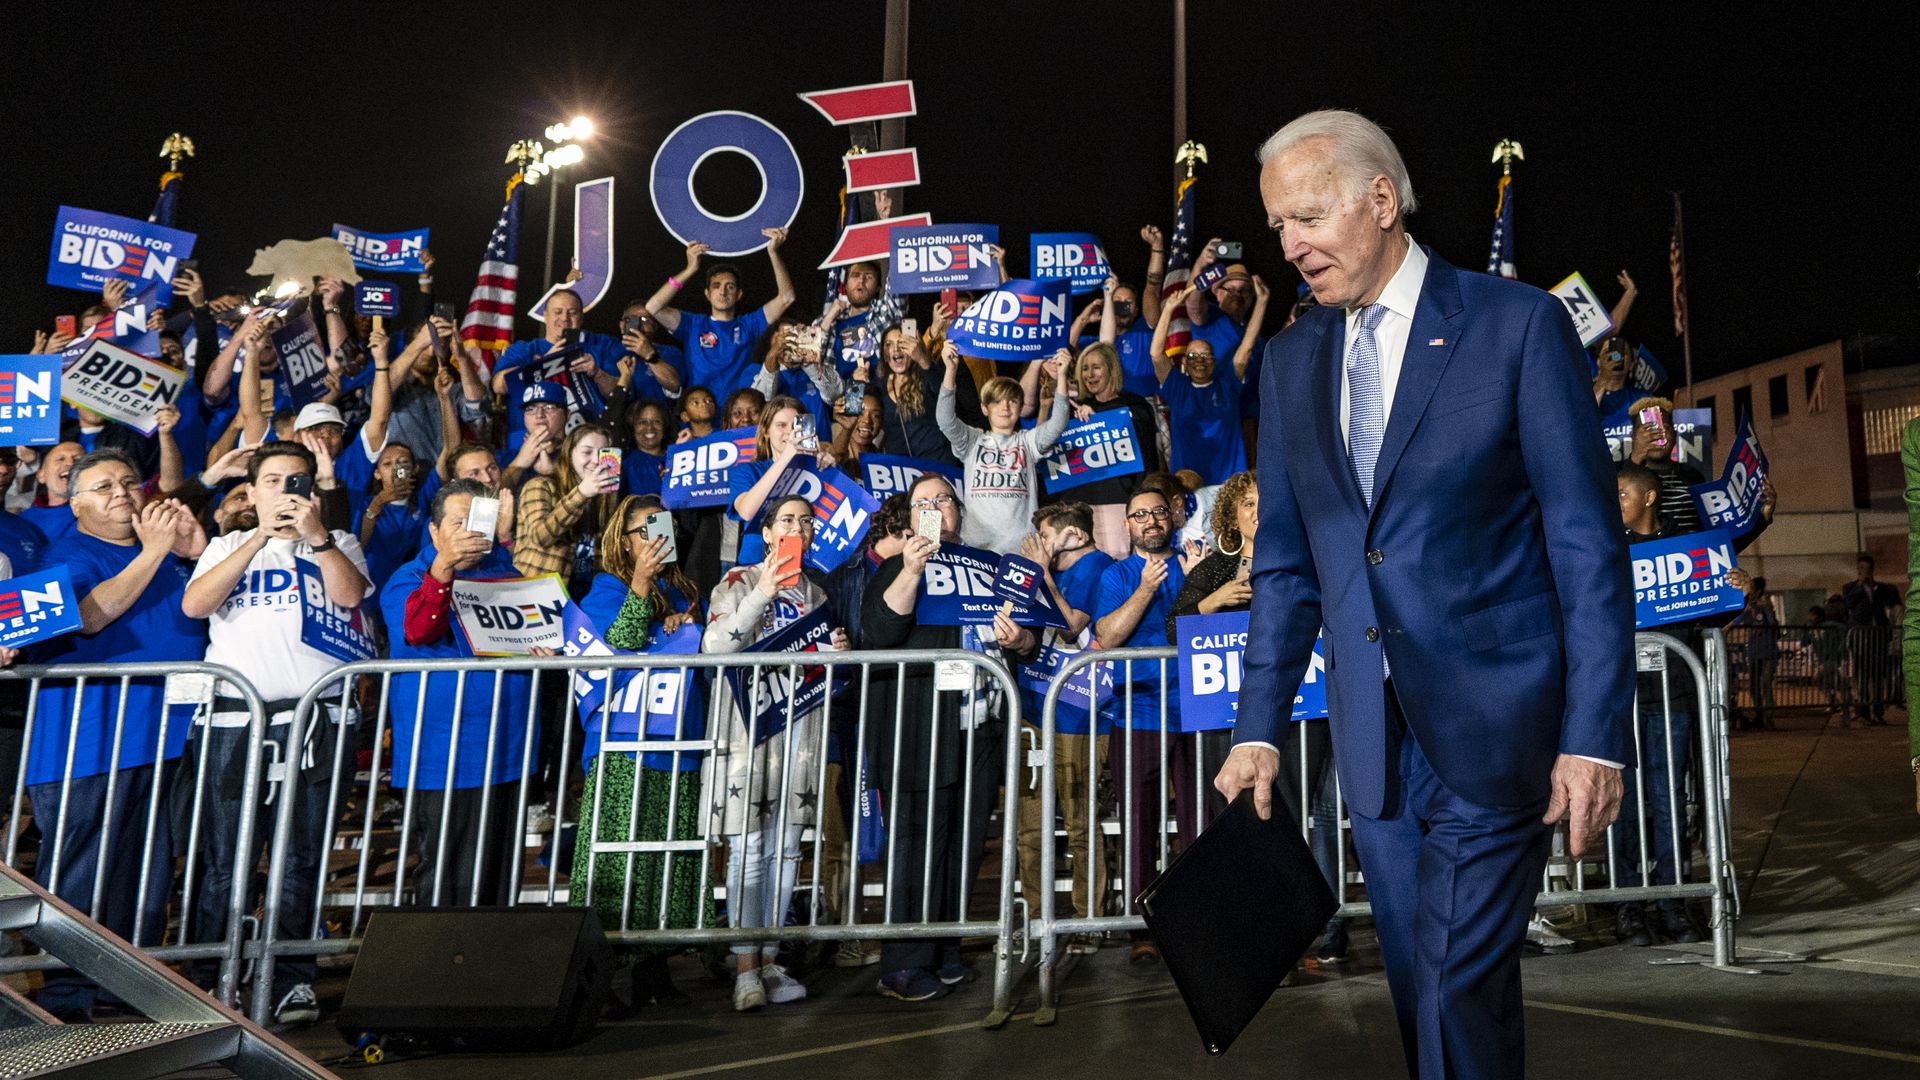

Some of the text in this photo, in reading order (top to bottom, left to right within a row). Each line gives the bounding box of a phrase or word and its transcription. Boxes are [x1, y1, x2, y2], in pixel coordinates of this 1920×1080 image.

[527, 79, 932, 322] JOE
[64, 221, 173, 253] CALIFORNIA FOR
[337, 230, 422, 255] BIDEN
[898, 234, 984, 247] CALIFORNIA FOR
[58, 233, 177, 284] BIDEN
[897, 243, 992, 274] BIDEN
[1036, 243, 1110, 268] BIDEN
[1036, 266, 1110, 278] PRESIDEN
[362, 290, 391, 303] JOE
[960, 289, 1066, 325] BIDEN
[954, 318, 1066, 340] PRESIDENT
[972, 340, 986, 348] Text
[986, 341, 1013, 352] UNITED
[1013, 343, 1021, 351] to
[286, 342, 325, 386] BID
[1636, 357, 1660, 392] BID
[78, 351, 178, 405] BIDEN
[68, 372, 161, 416] PRESIDENT
[1054, 427, 1130, 455] PRESIDEN
[1603, 424, 1633, 437] CALIF
[671, 437, 757, 478] BIDE
[975, 444, 1007, 467] JOE
[1046, 437, 1136, 481] BIDEN
[669, 469, 729, 489] PRESI
[972, 469, 1028, 489] BIDEN
[1709, 466, 1764, 527] PRESIDE
[1632, 544, 1733, 590] BIDEN
[1002, 570, 1034, 590] JOE
[1635, 576, 1724, 604] PRESIDEN
[226, 594, 299, 612] PRESID
[454, 591, 480, 602] Pride
[459, 601, 470, 610] for
[1655, 602, 1671, 613] Text
[1671, 600, 1689, 611] JOIN
[471, 600, 563, 630] BIDEN
[962, 604, 981, 612] Text
[981, 604, 994, 612] CA
[2, 626, 40, 641] 30330
[321, 631, 334, 644] Text
[522, 636, 534, 644] TO
[806, 622, 829, 643] FOR
[1191, 632, 1248, 650] CALIFO
[1024, 666, 1039, 678] Text
[794, 698, 804, 707] CA
